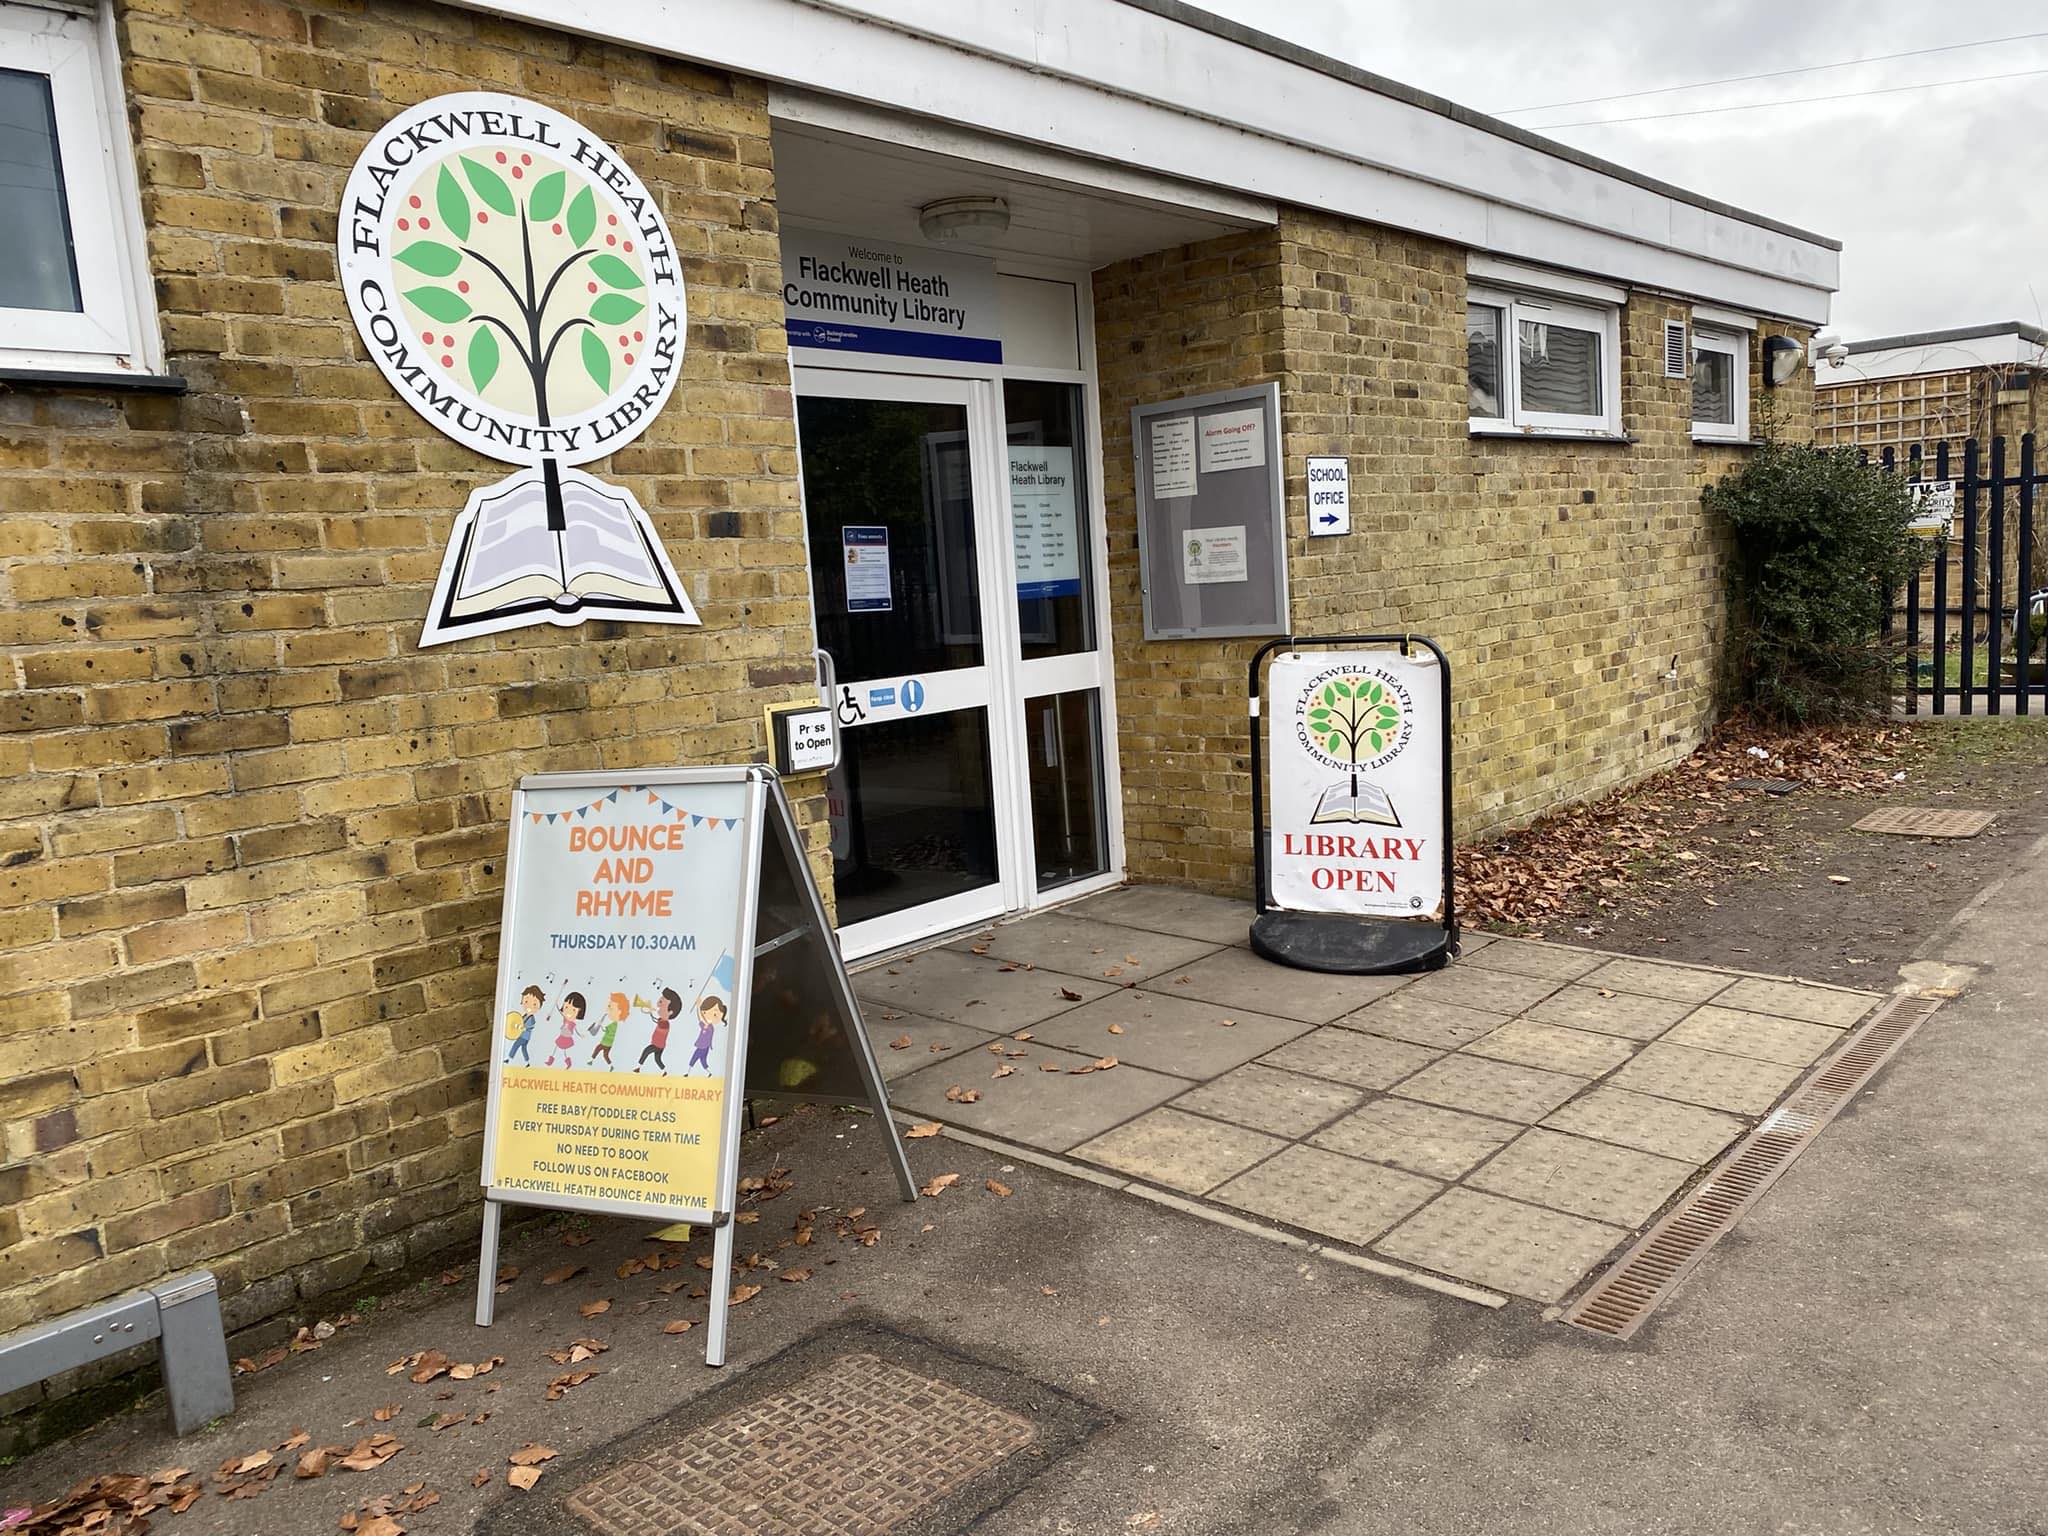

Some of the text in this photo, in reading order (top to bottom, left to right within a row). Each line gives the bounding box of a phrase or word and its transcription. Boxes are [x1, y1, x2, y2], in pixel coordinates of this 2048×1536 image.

[353, 111, 676, 286] FLACKWELL HEATH
[848, 246, 903, 265] Welcome to
[799, 256, 949, 297] Flackwell Heath
[783, 283, 966, 330] Community Library
[359, 279, 677, 452] COMMUNITY LIBRARY
[1223, 425, 1242, 435] Going
[1010, 461, 1048, 472] Flackwell
[1310, 468, 1346, 482] SCHOOL
[1012, 474, 1066, 487] Heath Library
[1314, 491, 1345, 505] OFFICE
[1296, 665, 1413, 715] FLACKWELL HEATH
[799, 723, 826, 735] Prss
[795, 738, 831, 751] to Open
[1296, 720, 1413, 772] COMMUNITY LIBRARY
[568, 824, 686, 852] BOUNCE
[1283, 833, 1427, 862] LIBRARY
[592, 857, 654, 884] AND
[1311, 868, 1398, 893] OPEN
[575, 890, 674, 917] RHYME
[550, 934, 696, 950] THURSDAY 10.30AM
[502, 1077, 722, 1102] FLACKWELL HEATH COMMUNITY LIBRARY
[536, 1103, 676, 1123] FREE BABY/TODDLER CLASS
[513, 1120, 701, 1145] EVERY THURSDAY DURING TERM TIME
[557, 1143, 649, 1161] NO NEED TO BOOK
[533, 1161, 669, 1184] FOLLOW US ON FACEBOOK
[504, 1177, 560, 1193] FLACKWELL
[563, 1183, 597, 1197] HEATH
[599, 1187, 641, 1201] BOUNCE
[644, 1191, 667, 1204] AND
[669, 1194, 707, 1208] RHYME
